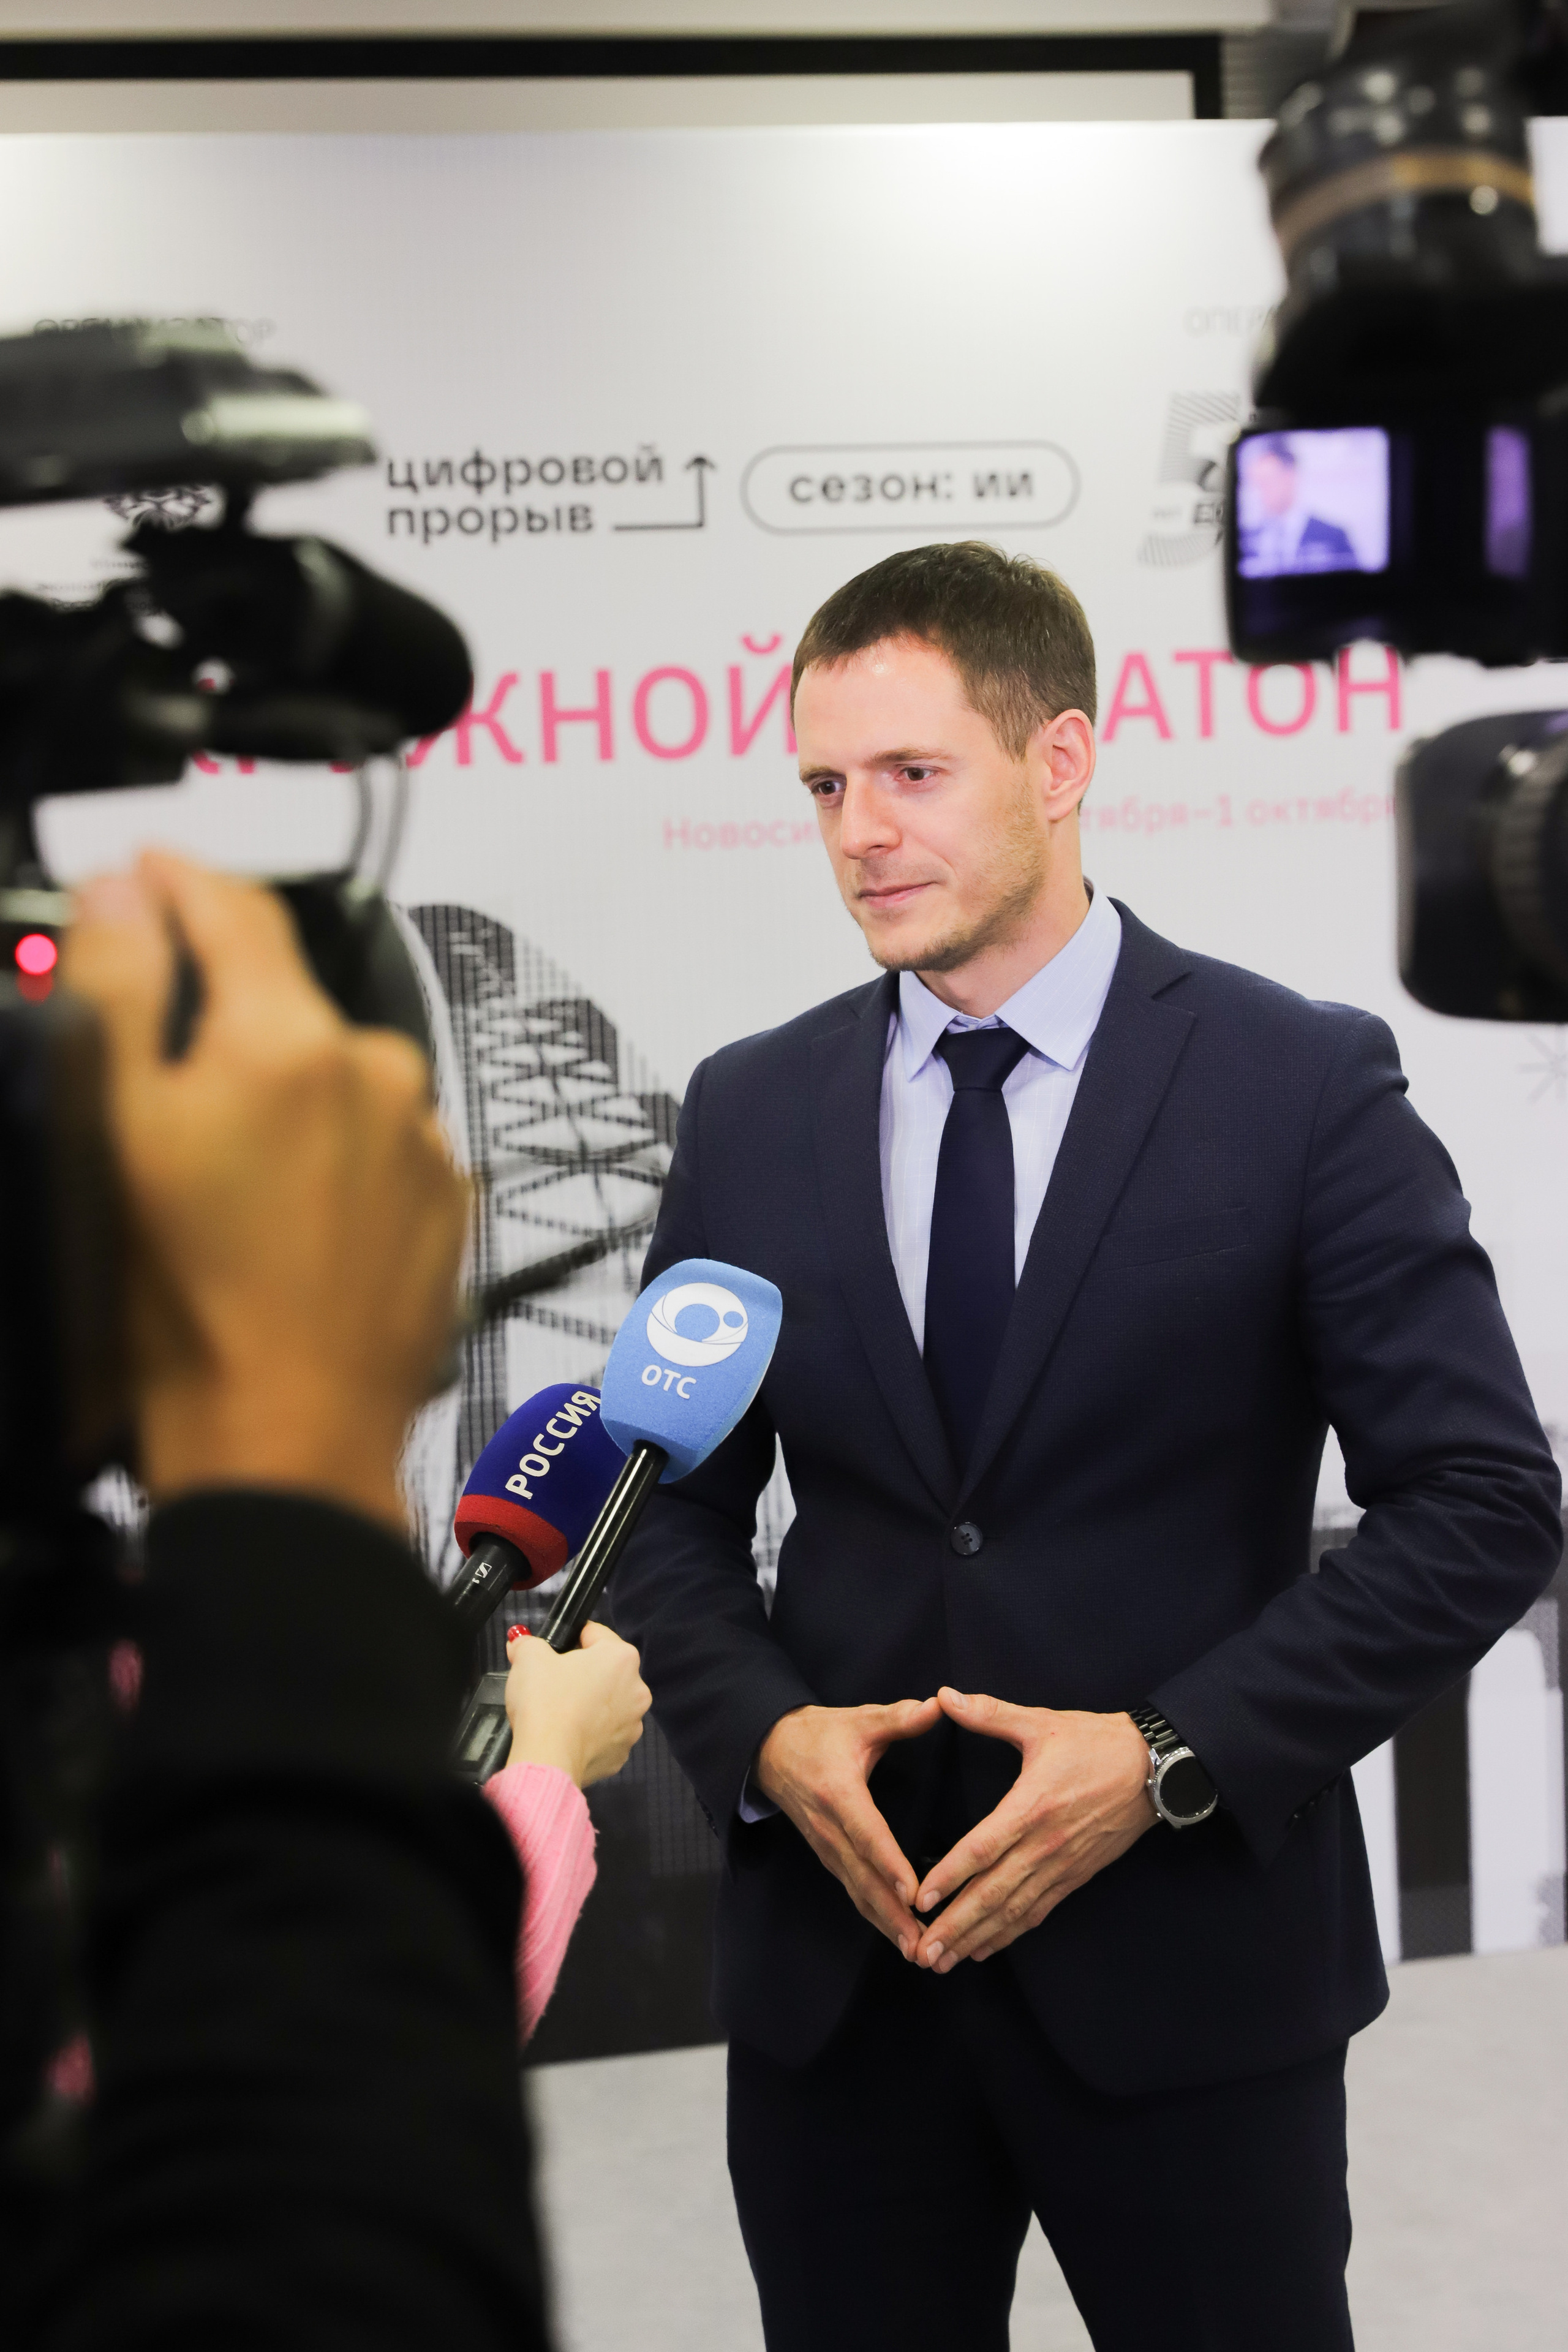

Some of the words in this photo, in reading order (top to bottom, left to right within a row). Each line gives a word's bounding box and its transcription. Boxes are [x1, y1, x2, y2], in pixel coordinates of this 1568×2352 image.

[386, 444, 664, 494] цифровой
[789, 470, 953, 503] сезон:
[386, 503, 594, 544] прорыв
[192, 632, 799, 774] ЖНОЙ
[1101, 644, 1401, 742] АТОН
[662, 816, 818, 851] Новоси
[641, 1364, 697, 1400] ОТС
[505, 1390, 601, 1500] РОССИЯ
